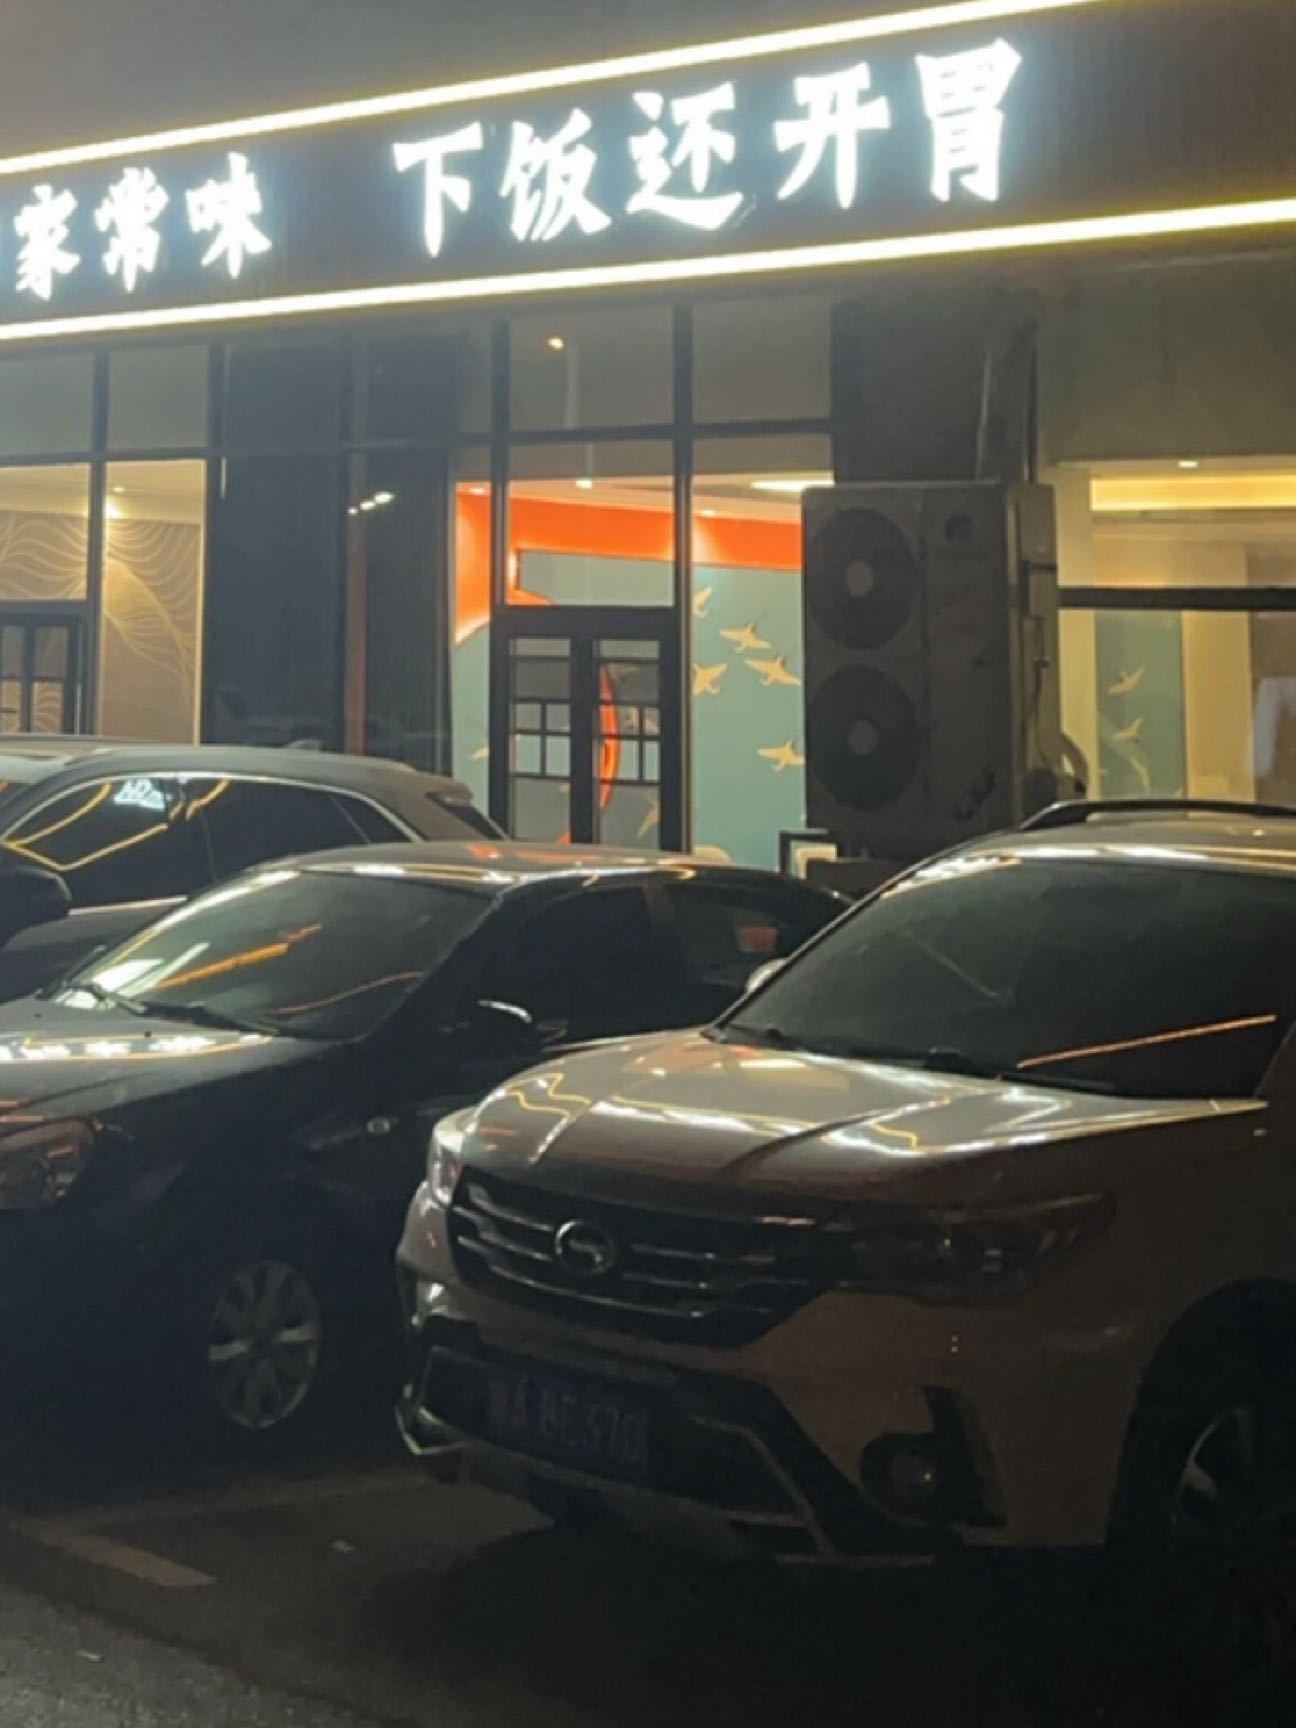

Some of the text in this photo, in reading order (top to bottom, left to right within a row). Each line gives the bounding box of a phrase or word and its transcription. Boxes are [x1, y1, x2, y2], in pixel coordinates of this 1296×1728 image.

[393, 38, 1025, 259] 下饭还开胃
